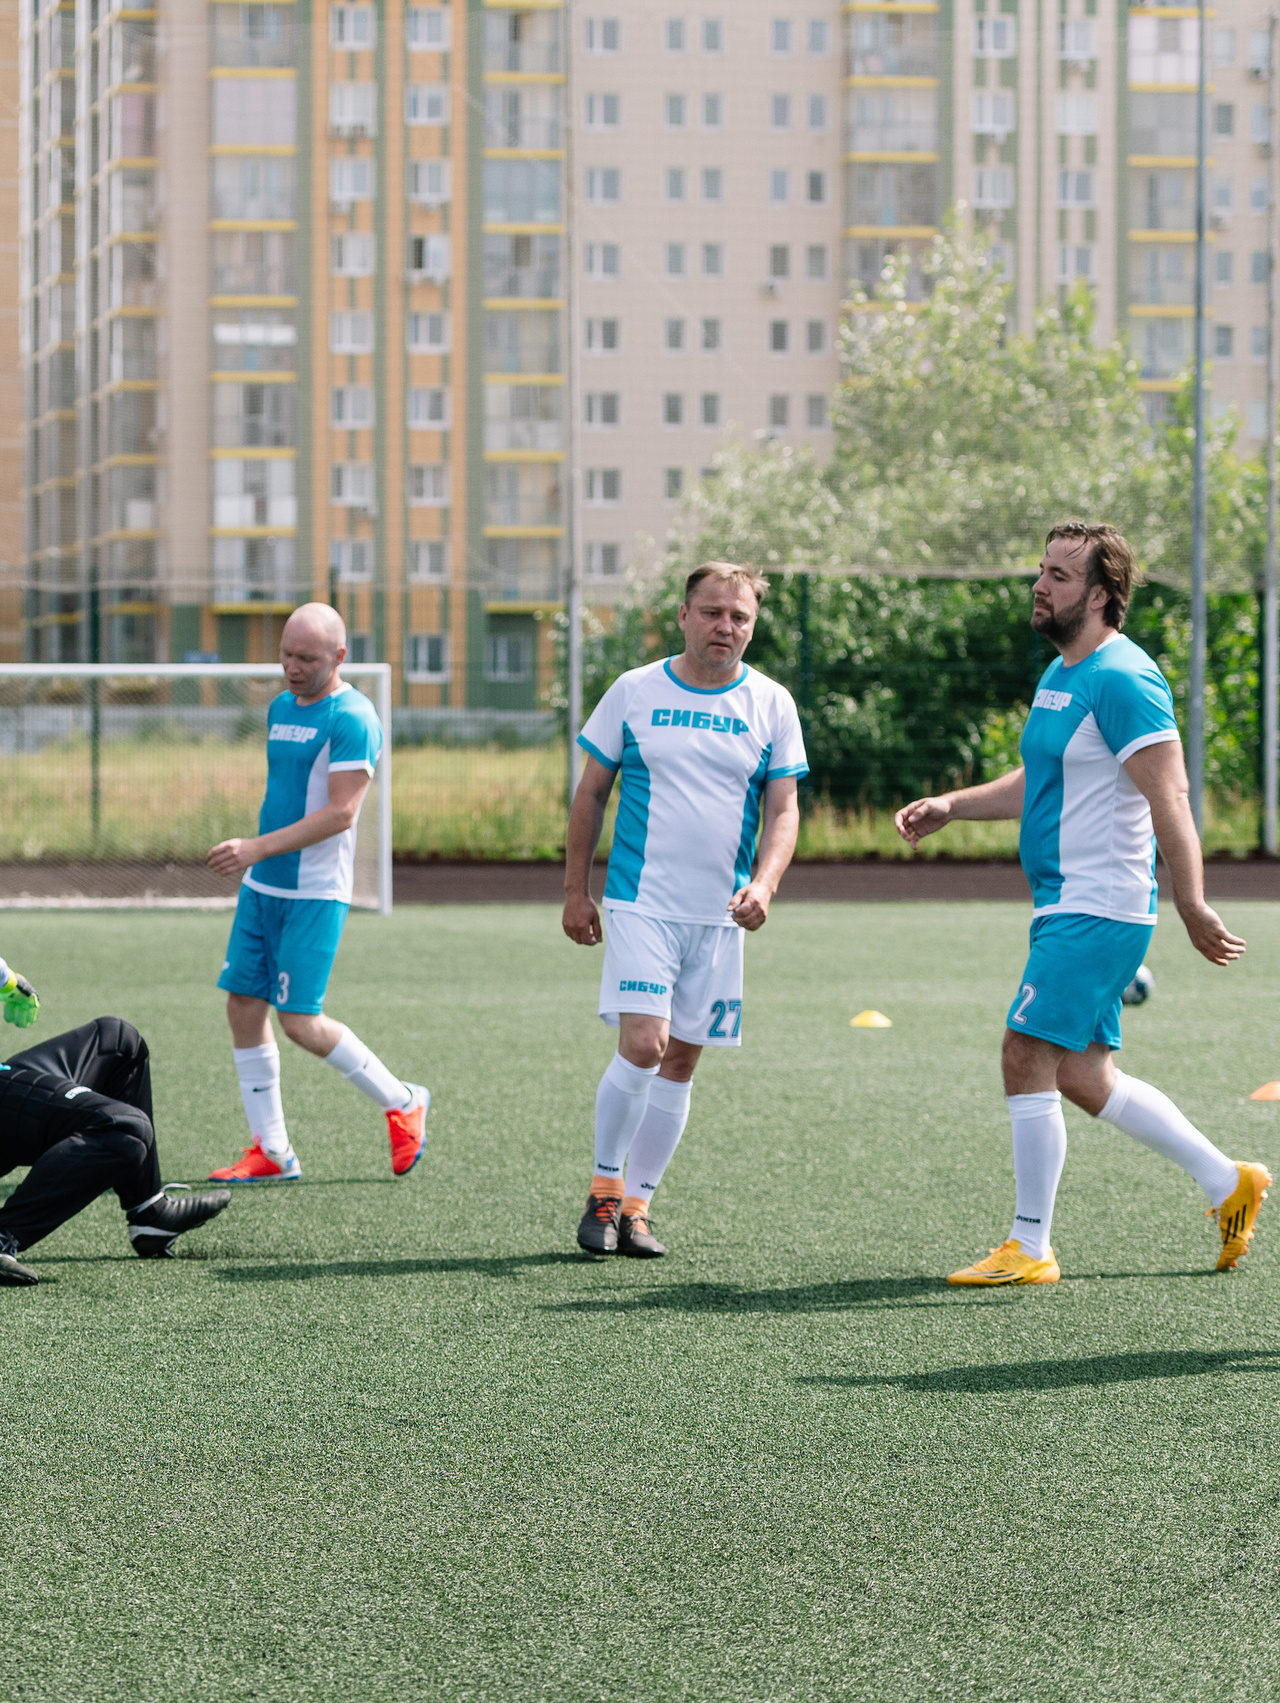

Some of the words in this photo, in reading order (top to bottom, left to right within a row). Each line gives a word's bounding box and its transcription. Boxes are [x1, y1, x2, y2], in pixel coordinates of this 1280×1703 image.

[1032, 688, 1073, 711] СИБУР
[269, 723, 318, 743] СИБУР
[650, 708, 749, 736] СИБУР
[276, 970, 290, 1005] 3
[619, 980, 667, 995] СИБУР
[707, 998, 742, 1038] 27
[1011, 982, 1037, 1026] 2
